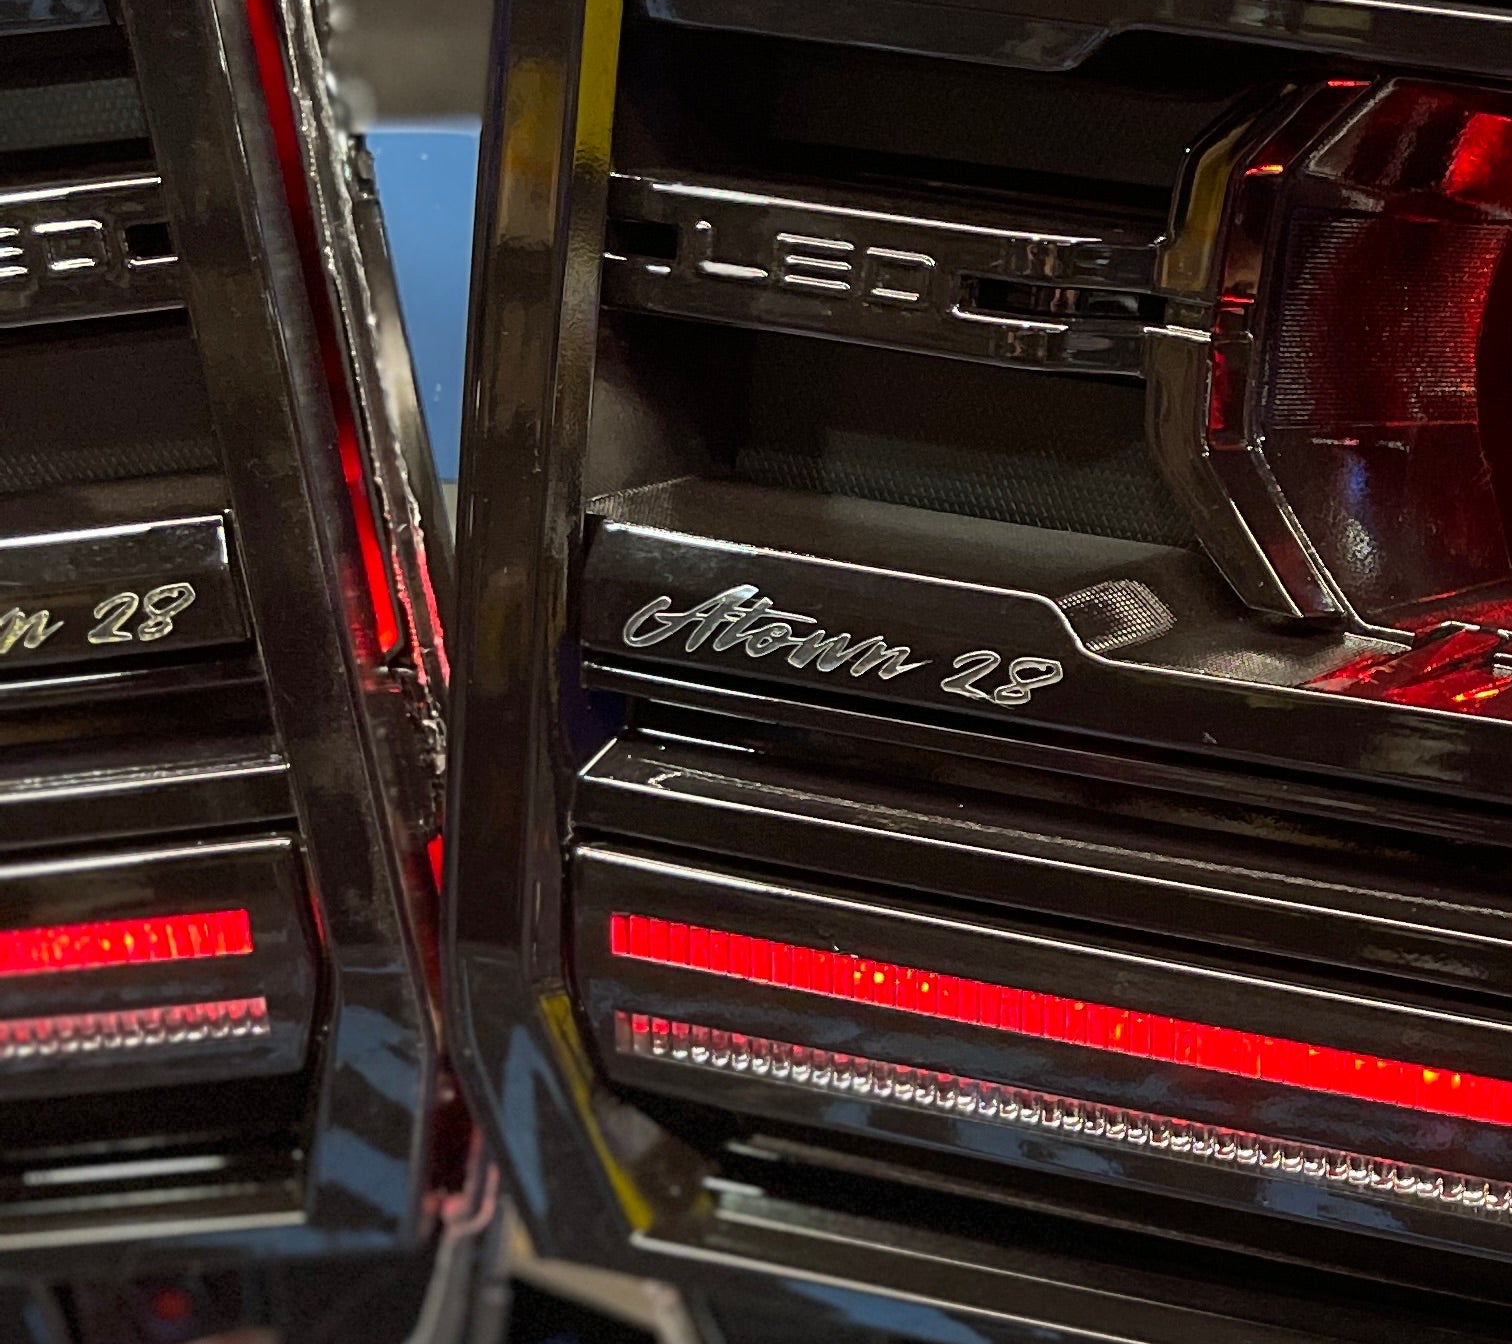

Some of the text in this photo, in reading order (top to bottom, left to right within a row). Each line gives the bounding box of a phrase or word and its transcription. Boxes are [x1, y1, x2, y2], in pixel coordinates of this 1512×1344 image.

[696, 220, 937, 302] LED
[87, 582, 196, 644] 28
[940, 649, 1064, 708] 28
